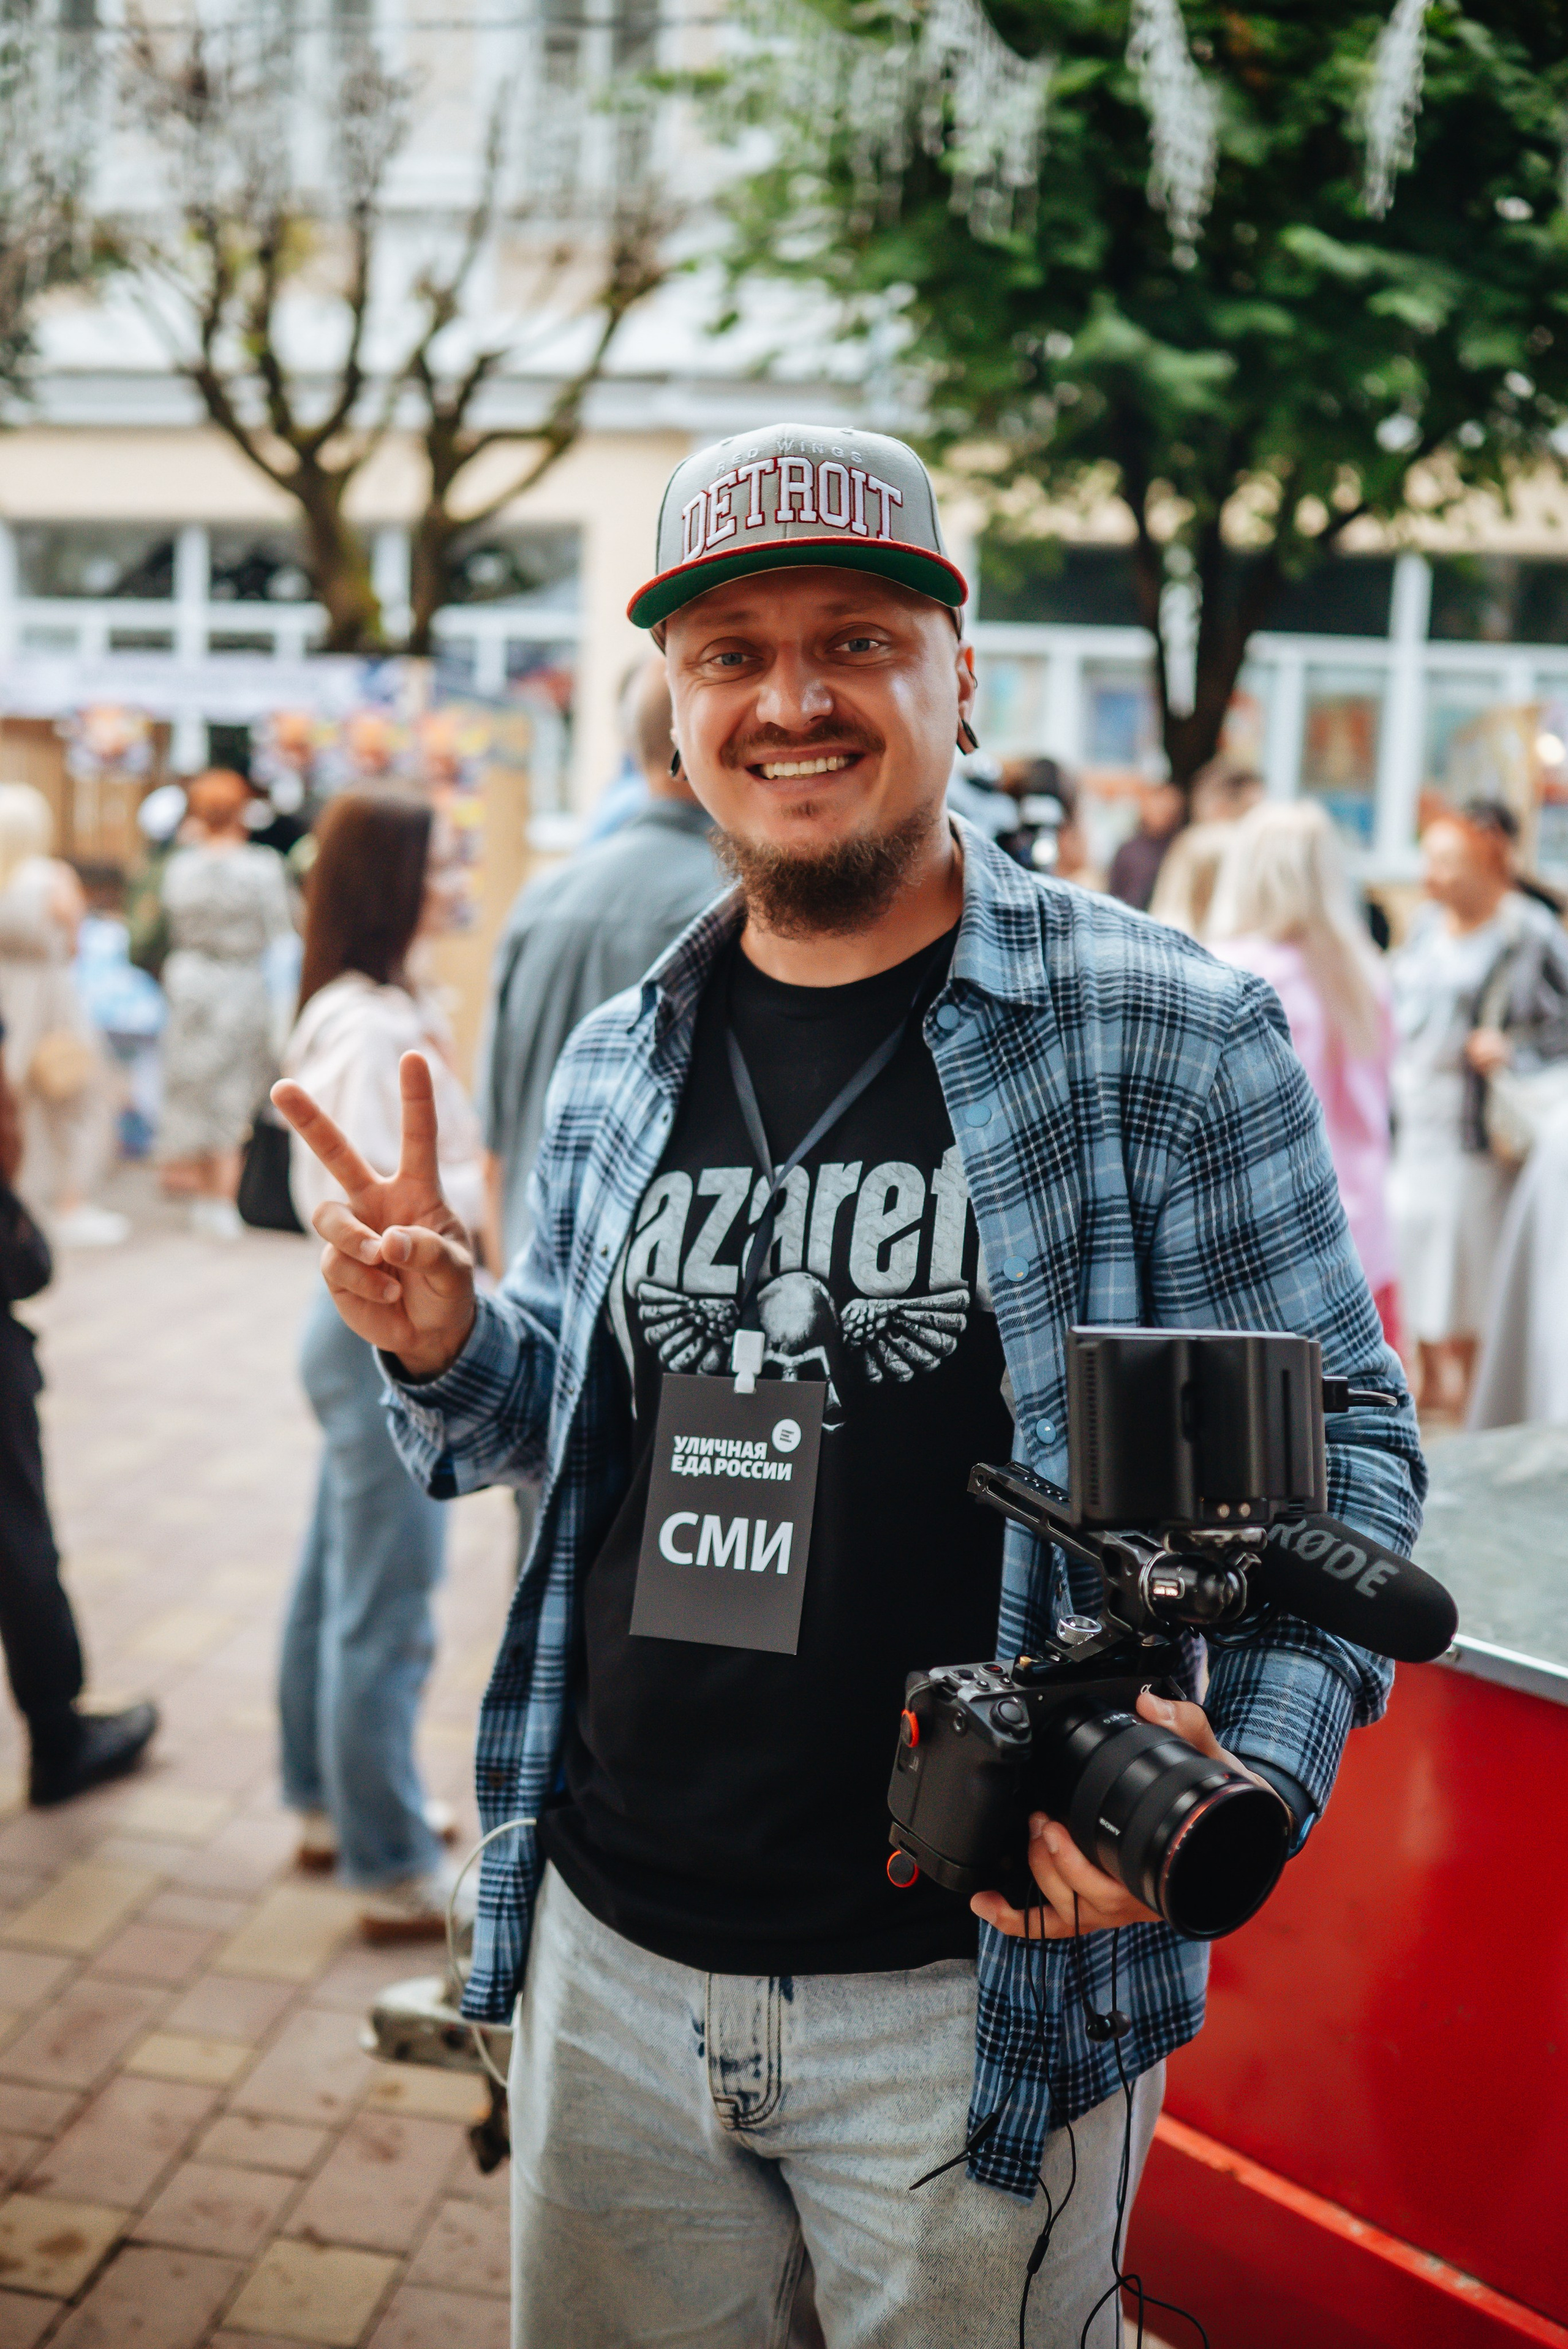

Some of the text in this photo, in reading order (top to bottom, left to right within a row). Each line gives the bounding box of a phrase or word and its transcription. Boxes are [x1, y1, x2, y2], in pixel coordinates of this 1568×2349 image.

[716, 440, 864, 475] RED WINGS
[682, 455, 903, 564] DETROIT
[620, 1142, 992, 1311] azaret
[674, 1435, 768, 1460] УЛИЧНАЯ
[671, 1454, 793, 1481] ЕДА РОССИИ
[658, 1510, 794, 1575] СМИ
[1099, 1816, 1121, 1836] SONY
